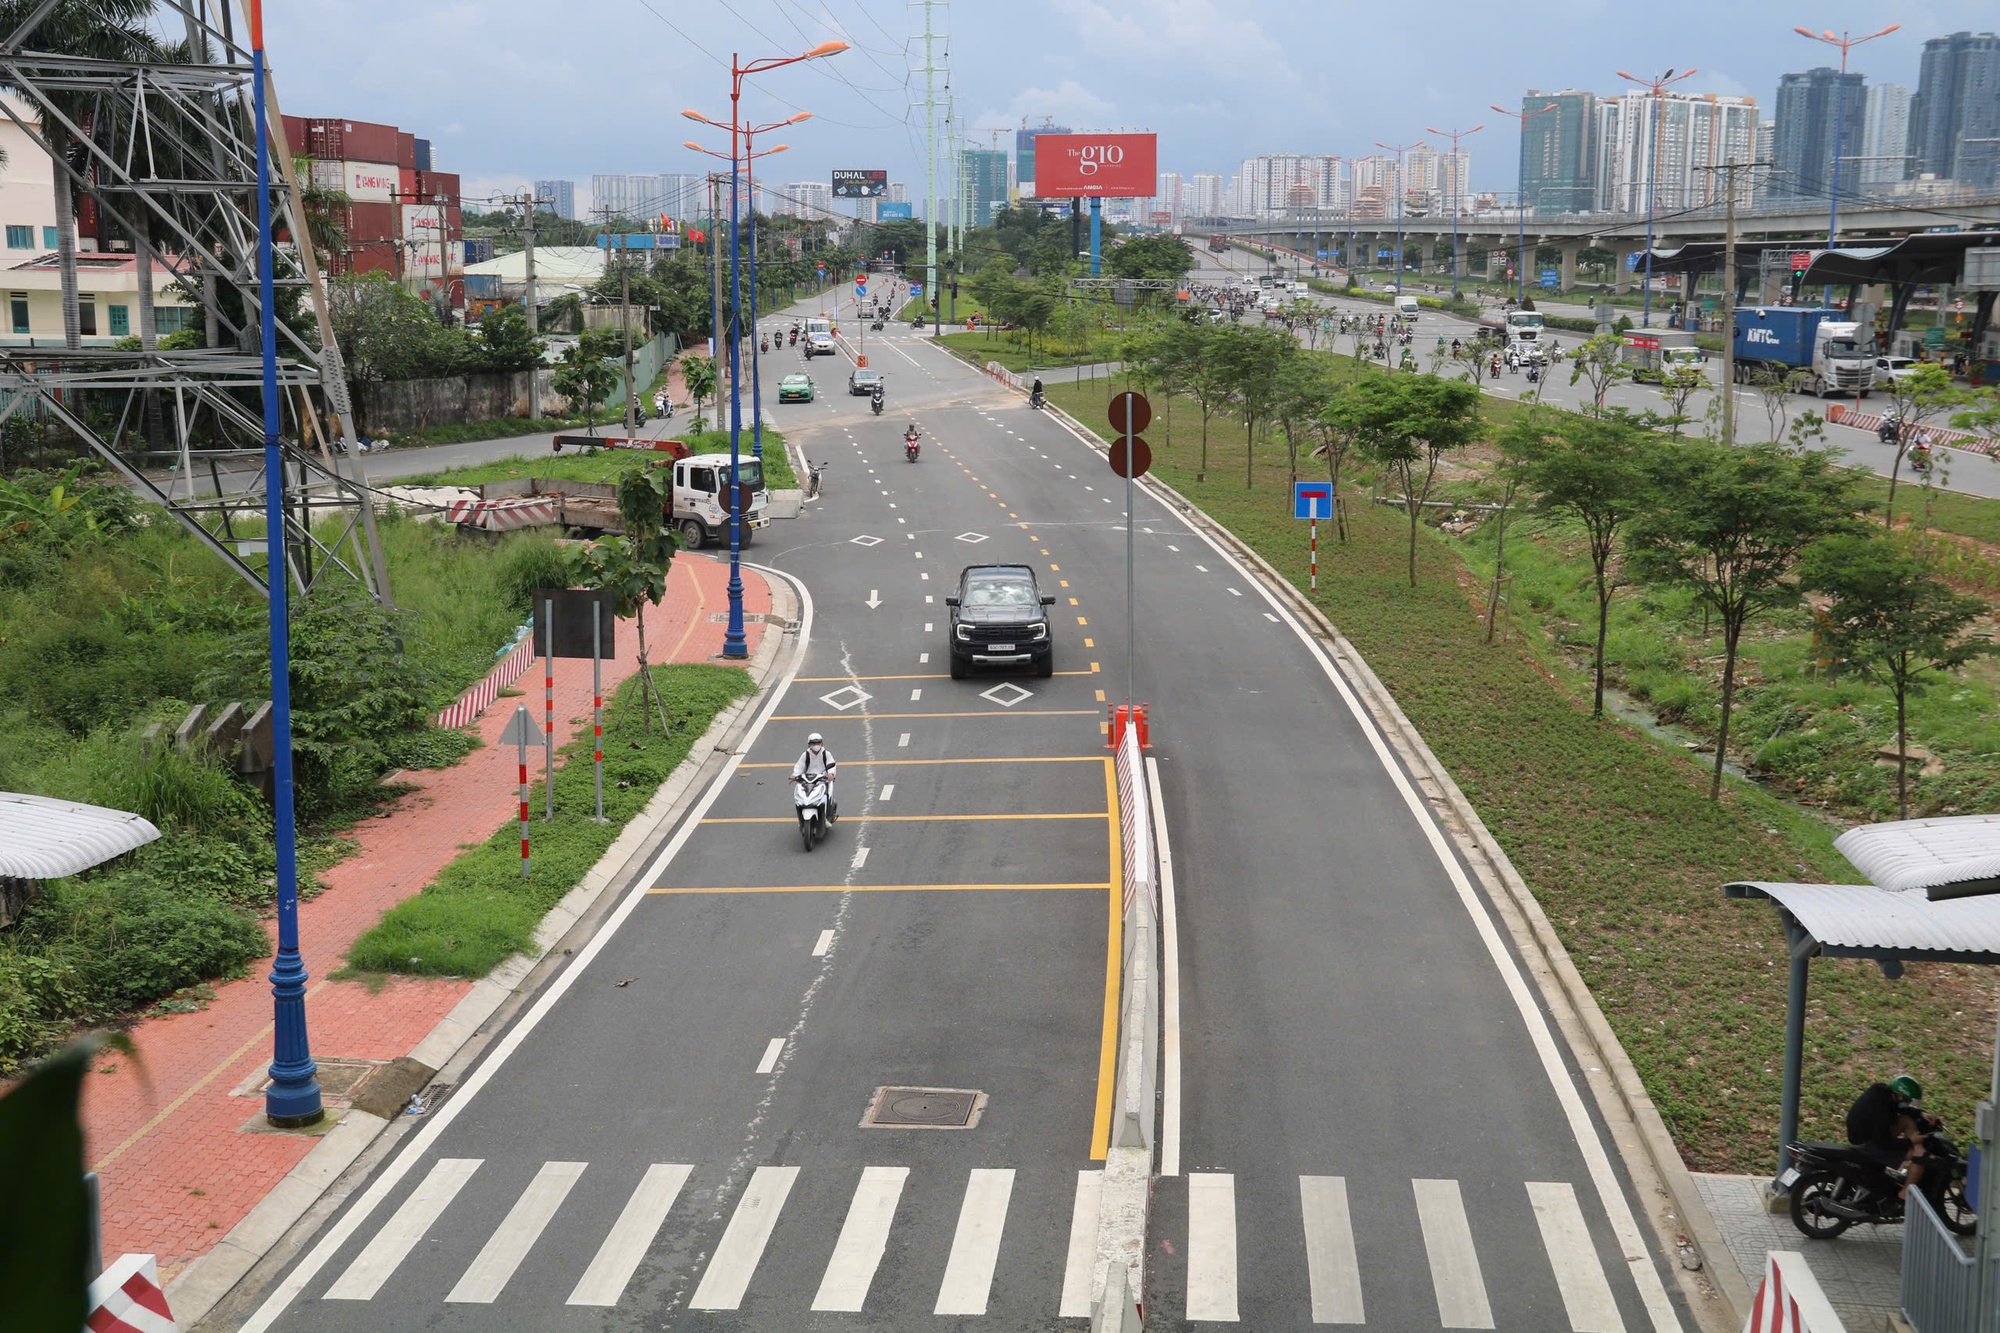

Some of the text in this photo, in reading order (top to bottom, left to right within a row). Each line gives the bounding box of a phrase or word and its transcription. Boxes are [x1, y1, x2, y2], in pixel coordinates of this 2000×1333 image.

[1067, 148, 1081, 157] The
[834, 171, 885, 180] DUHAL LED
